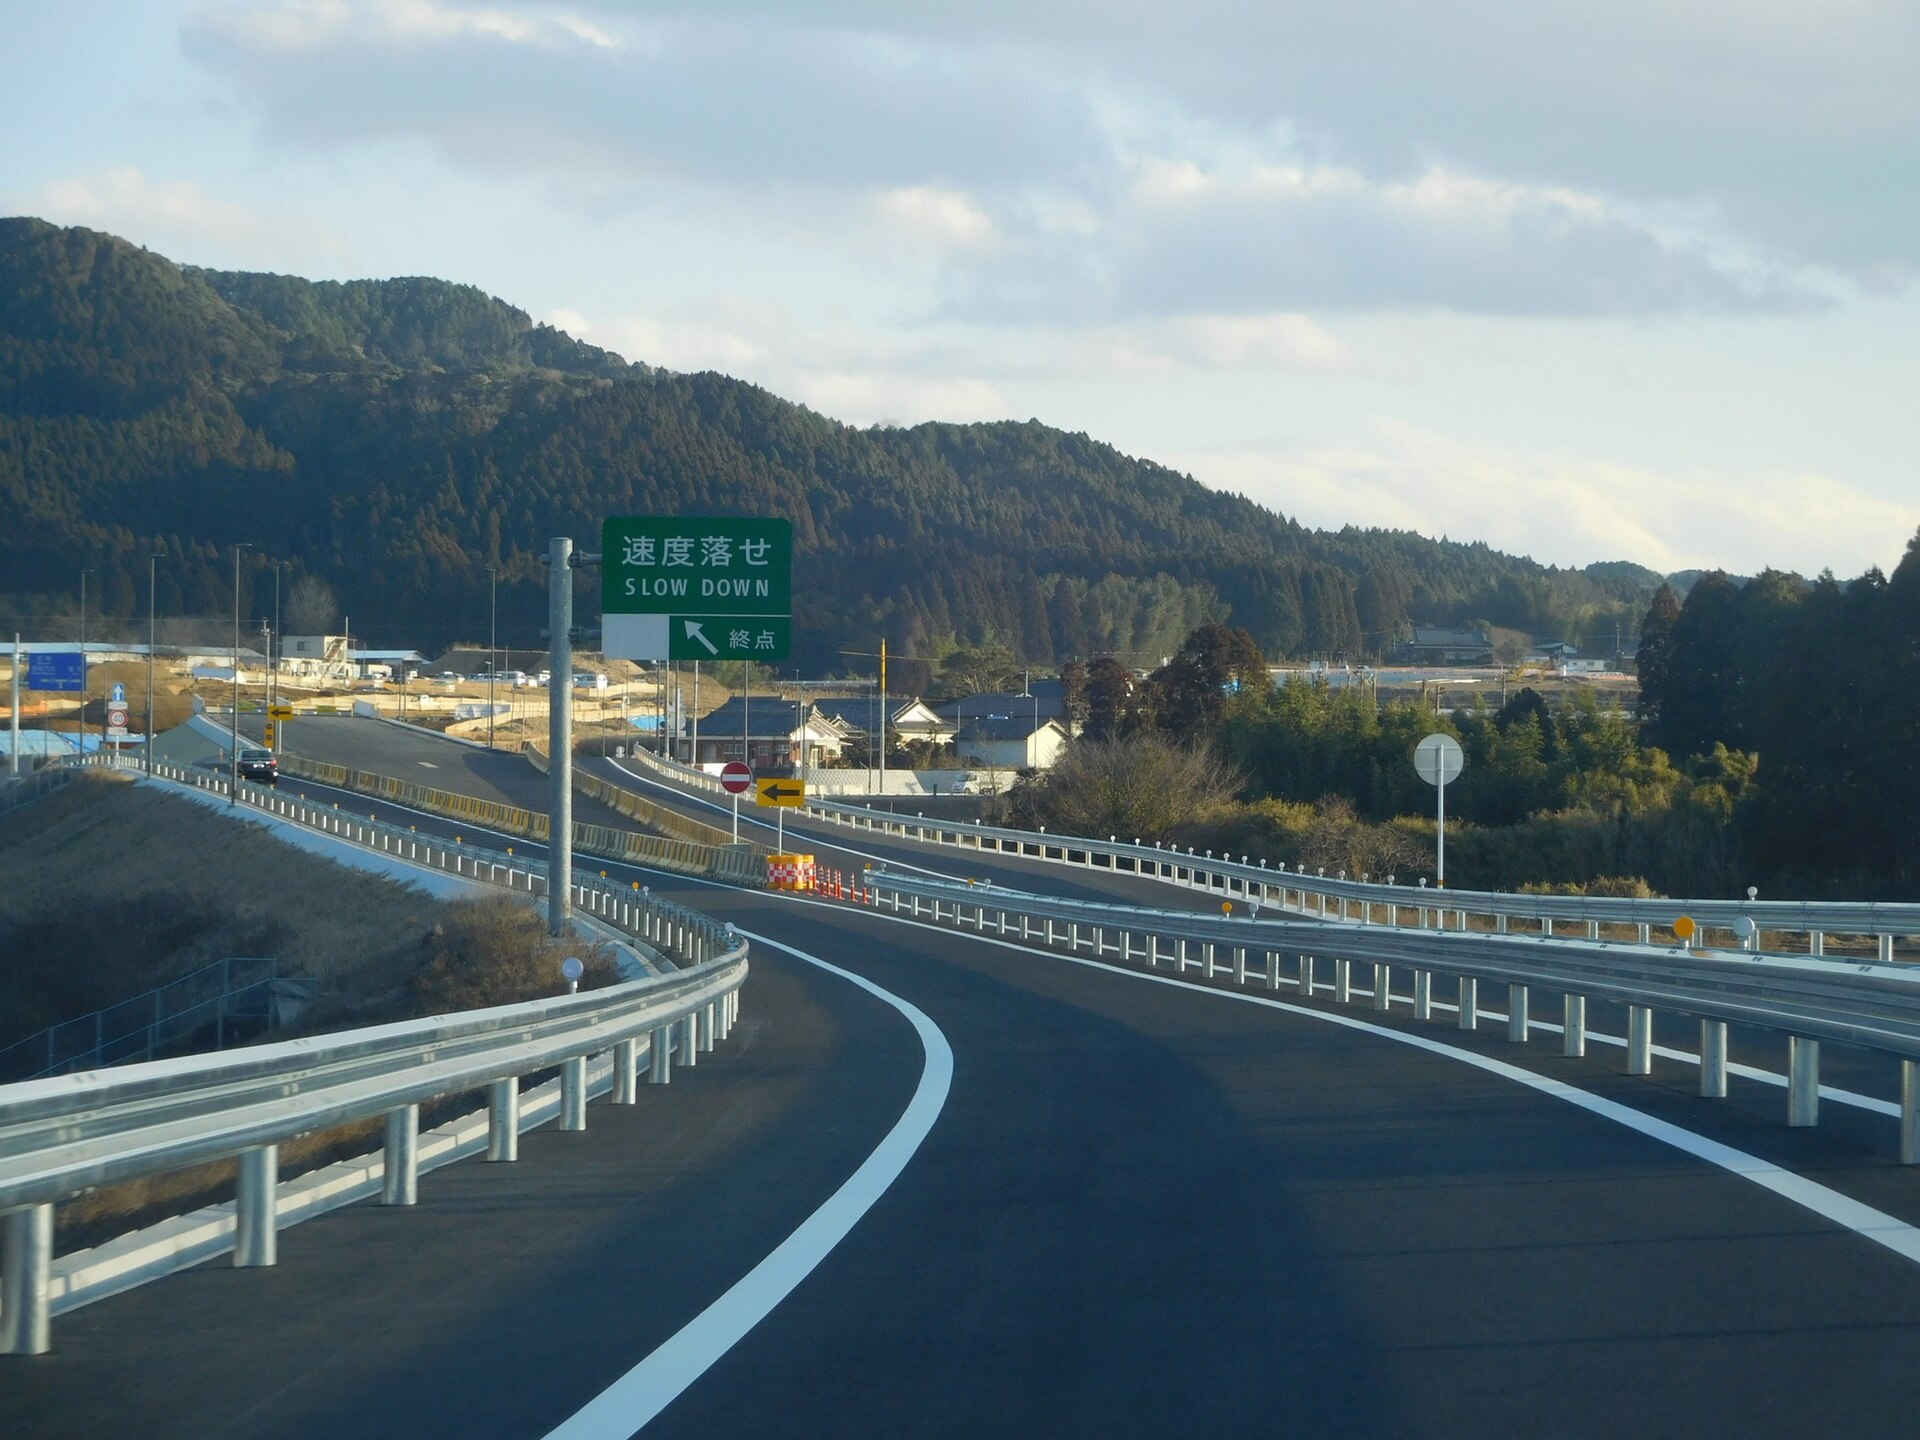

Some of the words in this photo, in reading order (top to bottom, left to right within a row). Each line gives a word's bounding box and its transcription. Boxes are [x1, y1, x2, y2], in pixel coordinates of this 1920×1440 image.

[622, 535, 771, 567] 速度落せ
[625, 577, 688, 596] SLOW
[701, 578, 769, 597] DOWN
[729, 629, 775, 650] 終点
